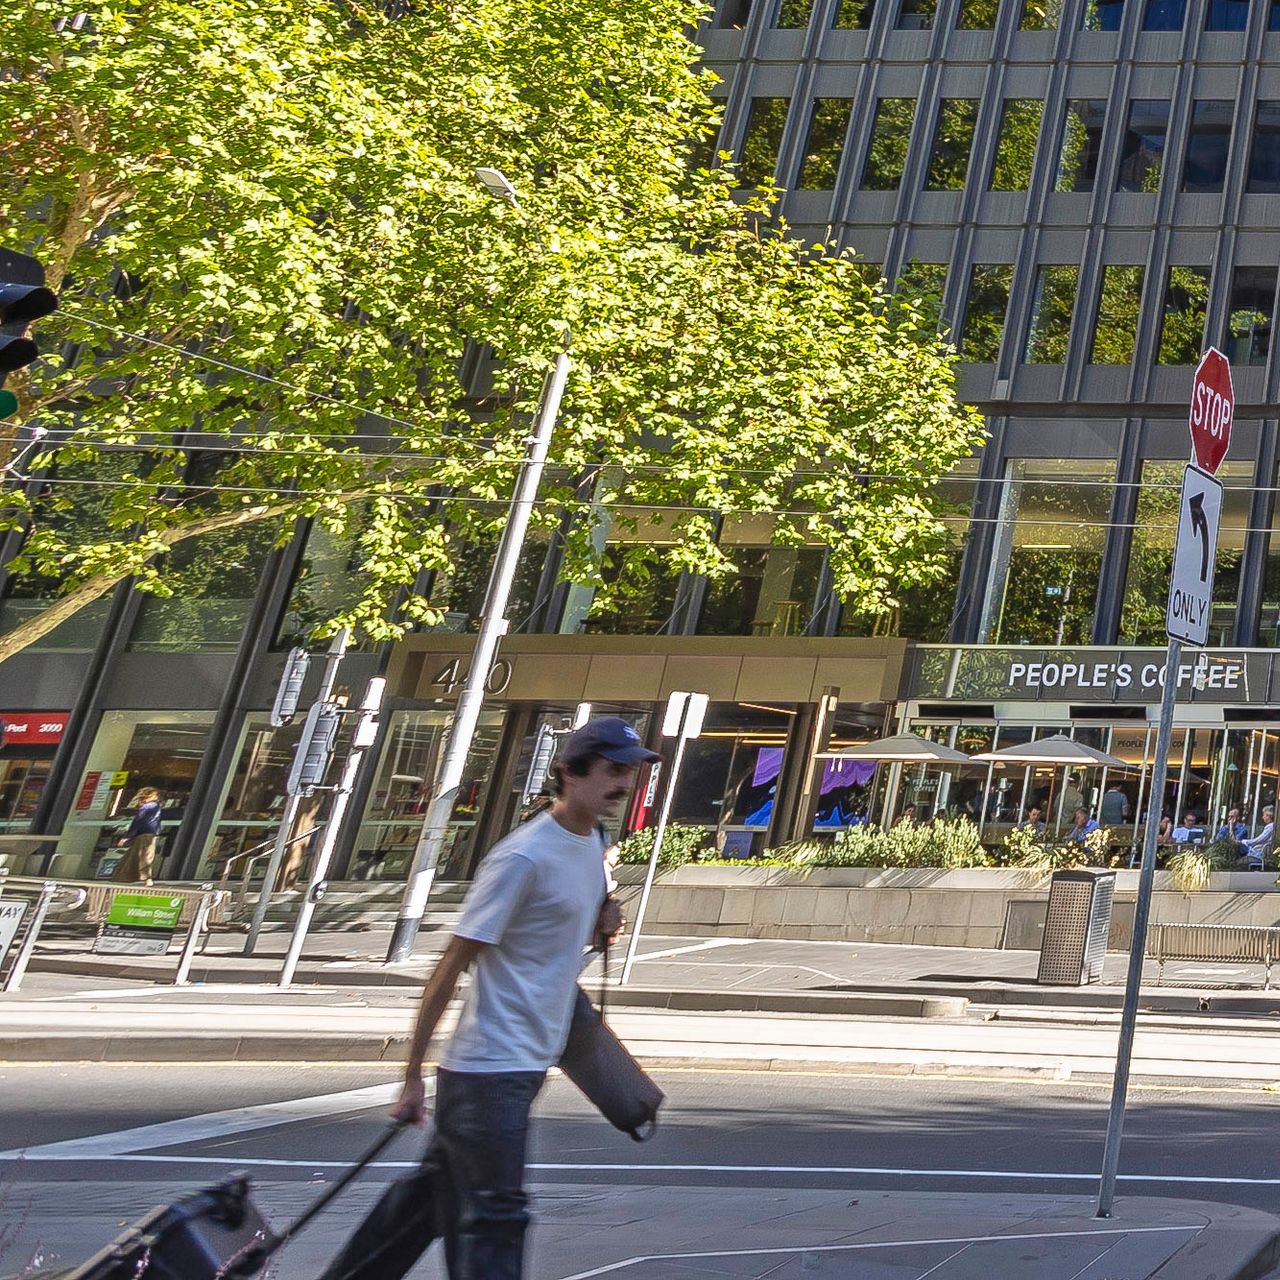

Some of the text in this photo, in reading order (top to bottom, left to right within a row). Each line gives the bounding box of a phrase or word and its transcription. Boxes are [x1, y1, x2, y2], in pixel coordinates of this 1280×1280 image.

[1193, 381, 1231, 440] STOP
[1172, 588, 1208, 627] ONLY
[432, 659, 512, 696] 40
[1008, 663, 1133, 687] PEOPLE'S
[127, 908, 176, 919] William Street
